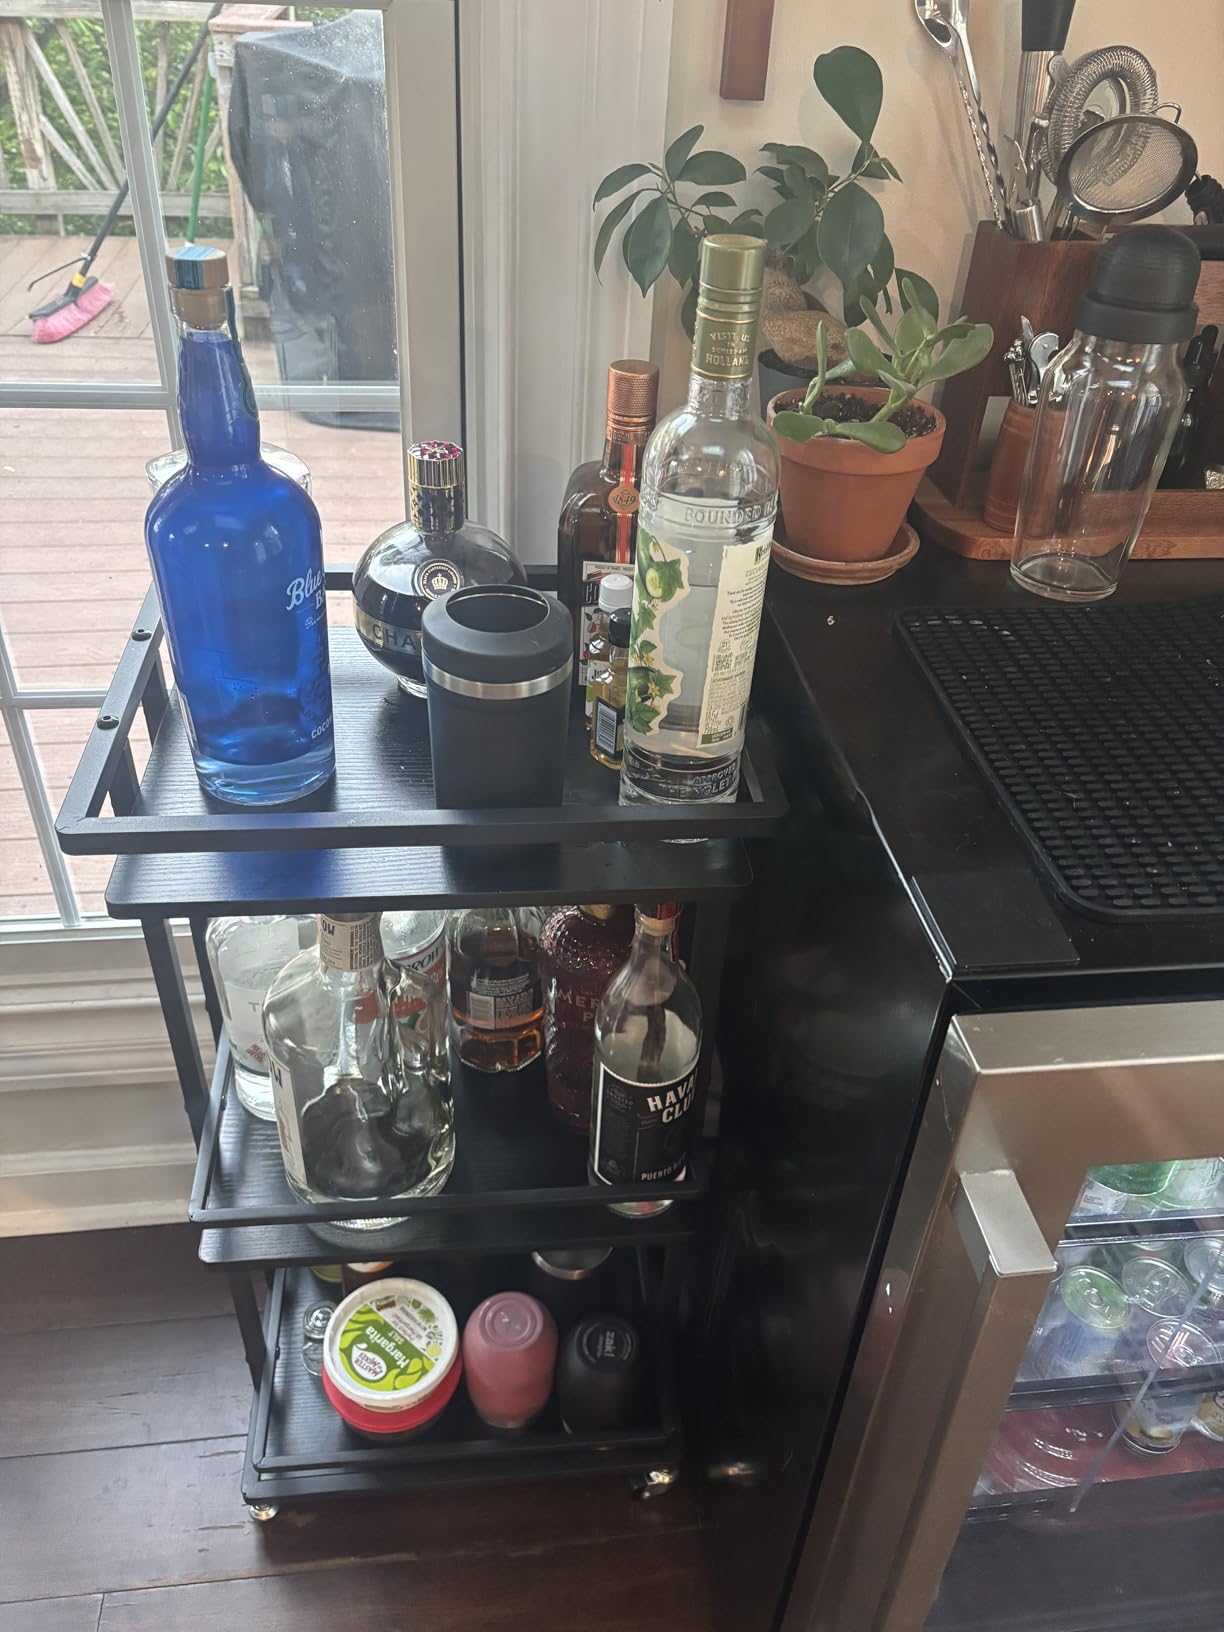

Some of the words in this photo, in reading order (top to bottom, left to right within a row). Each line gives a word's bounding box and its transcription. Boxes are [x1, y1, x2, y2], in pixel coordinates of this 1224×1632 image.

[685, 504, 762, 525] FOUNDED
[285, 567, 323, 611] Blue
[646, 1069, 698, 1112] HAVA
[662, 1091, 696, 1124] CLU
[364, 1325, 410, 1369] Margarita
[604, 1330, 617, 1358] zak!
